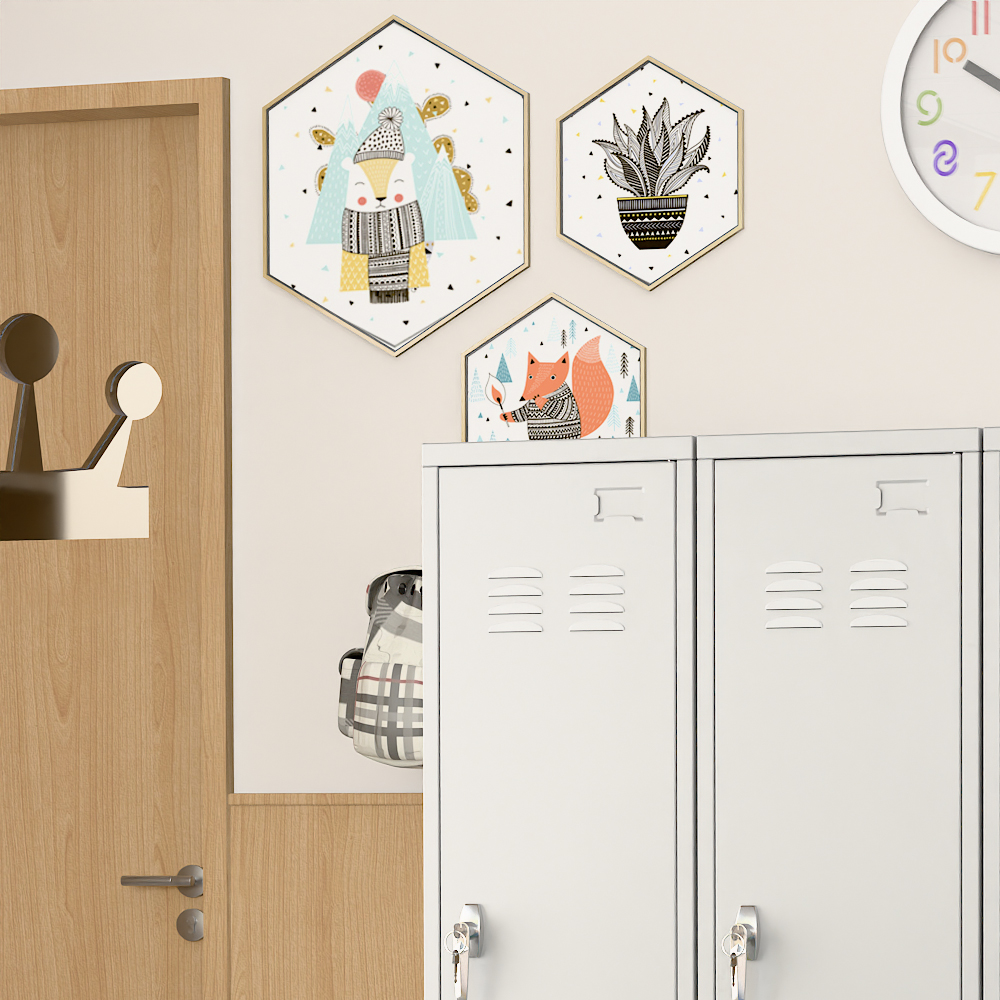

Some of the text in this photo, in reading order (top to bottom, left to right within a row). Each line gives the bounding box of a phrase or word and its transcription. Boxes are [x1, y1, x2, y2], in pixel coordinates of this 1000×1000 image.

[971, 0, 988, 36] 11
[933, 37, 967, 74] 10
[916, 89, 943, 126] 9
[932, 139, 959, 177] 8
[973, 171, 998, 211] 7
